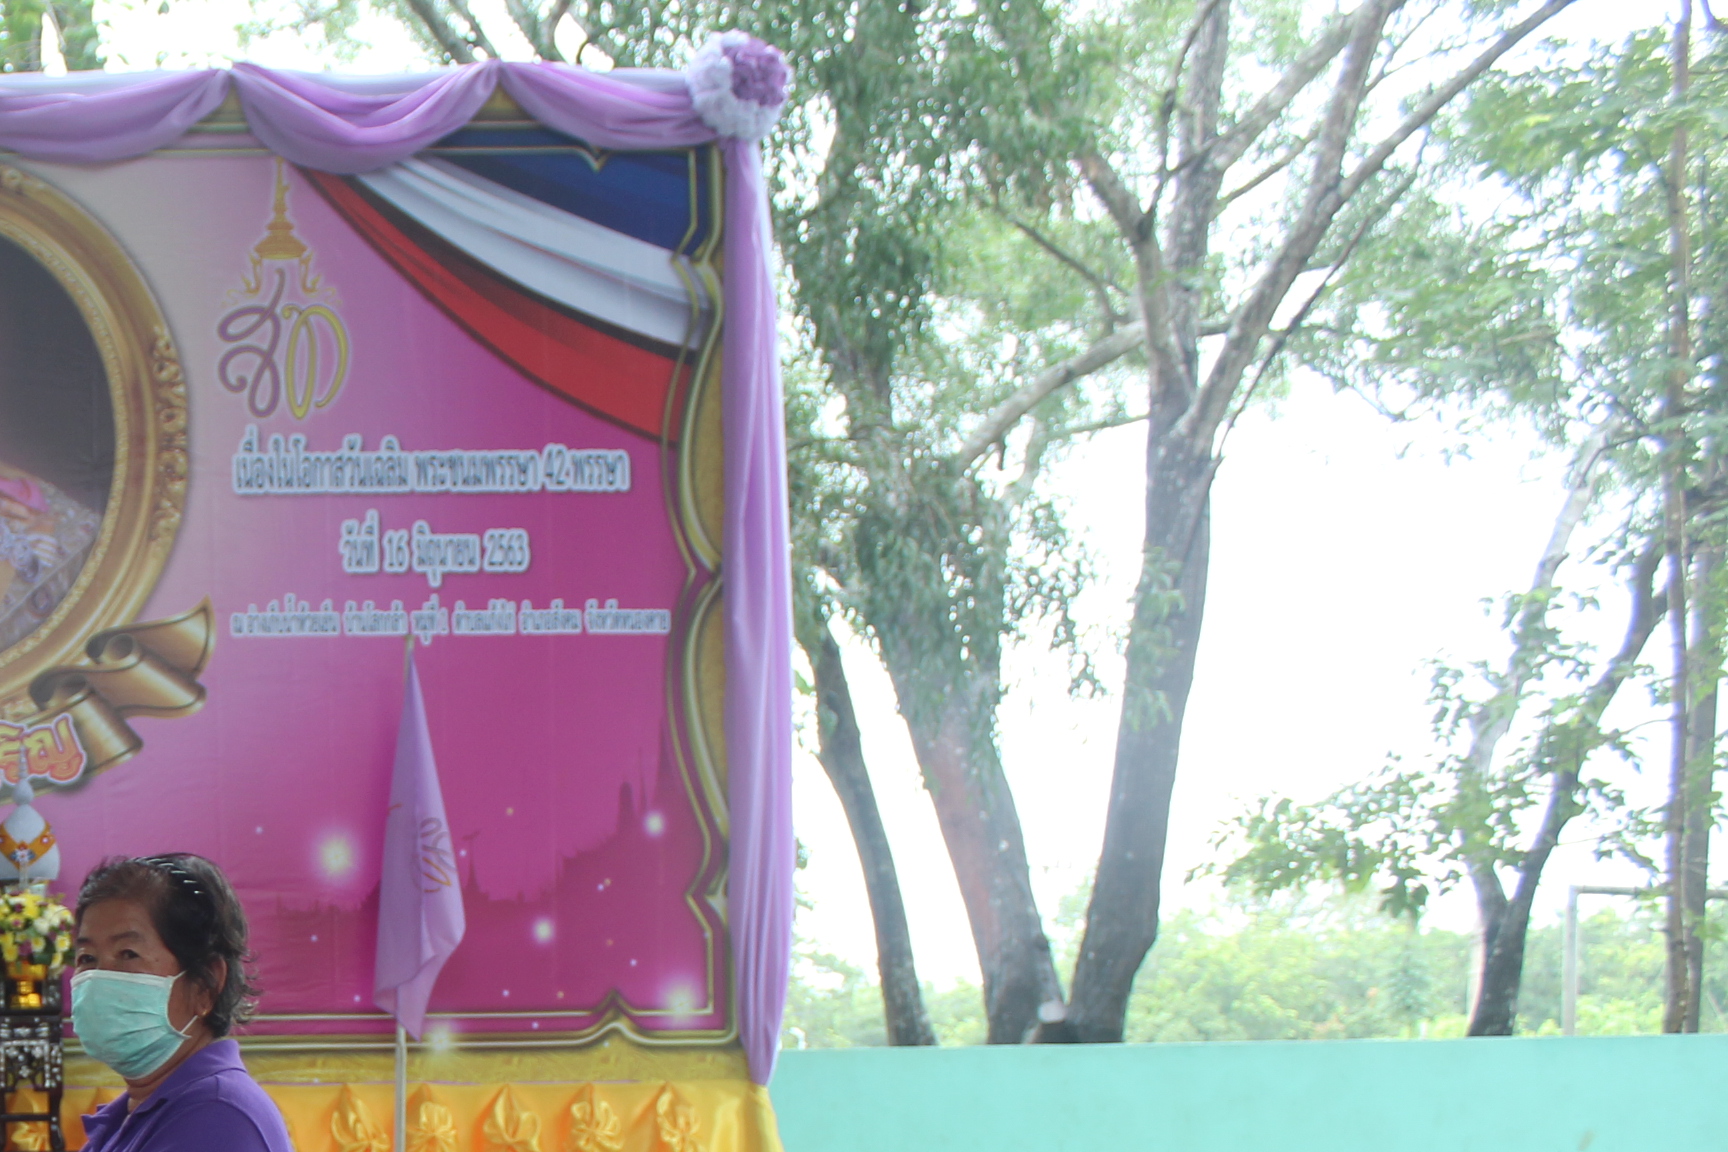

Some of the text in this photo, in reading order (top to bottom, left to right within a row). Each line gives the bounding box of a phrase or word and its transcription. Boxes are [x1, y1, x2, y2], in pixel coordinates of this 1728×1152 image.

[544, 446, 567, 488] 42
[570, 451, 627, 489] พรรษา
[342, 512, 528, 584] วันที่ 16 มิถุนายน 2563
